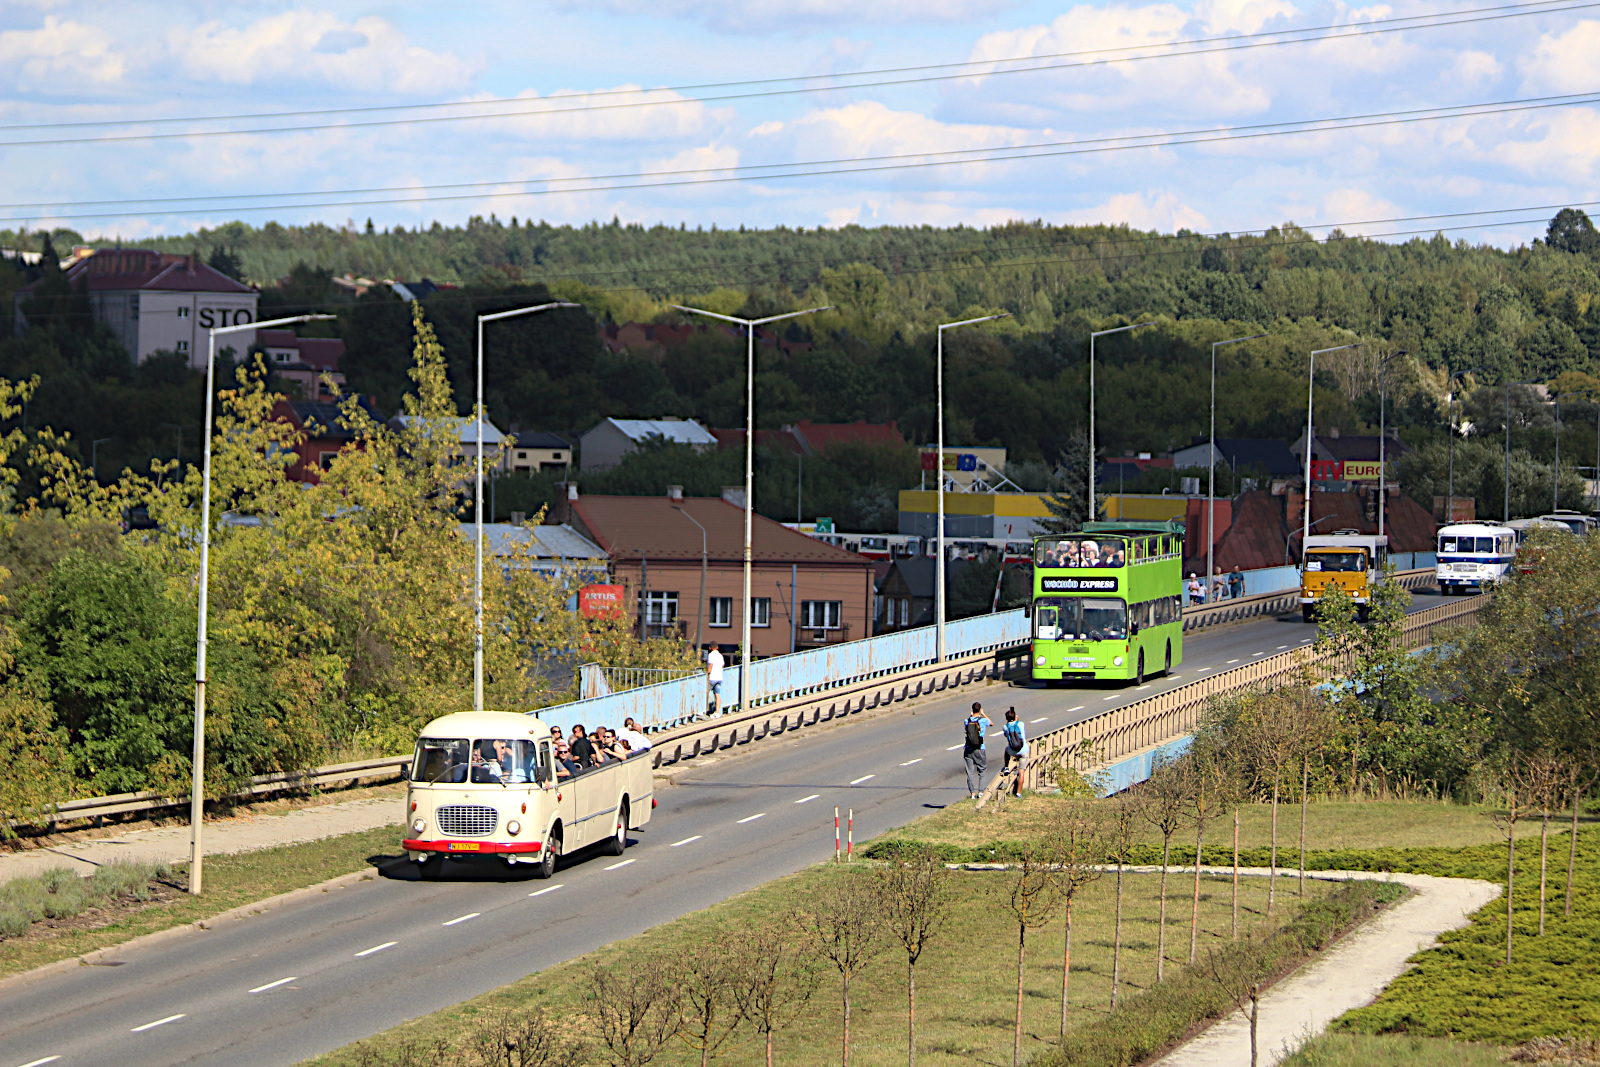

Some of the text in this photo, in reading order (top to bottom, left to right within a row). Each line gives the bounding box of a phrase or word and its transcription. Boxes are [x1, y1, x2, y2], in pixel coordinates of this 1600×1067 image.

[1310, 460, 1344, 481] RTV
[1044, 578, 1115, 589] WSCHÓD EXPRESS
[585, 592, 616, 601] ARTUS
